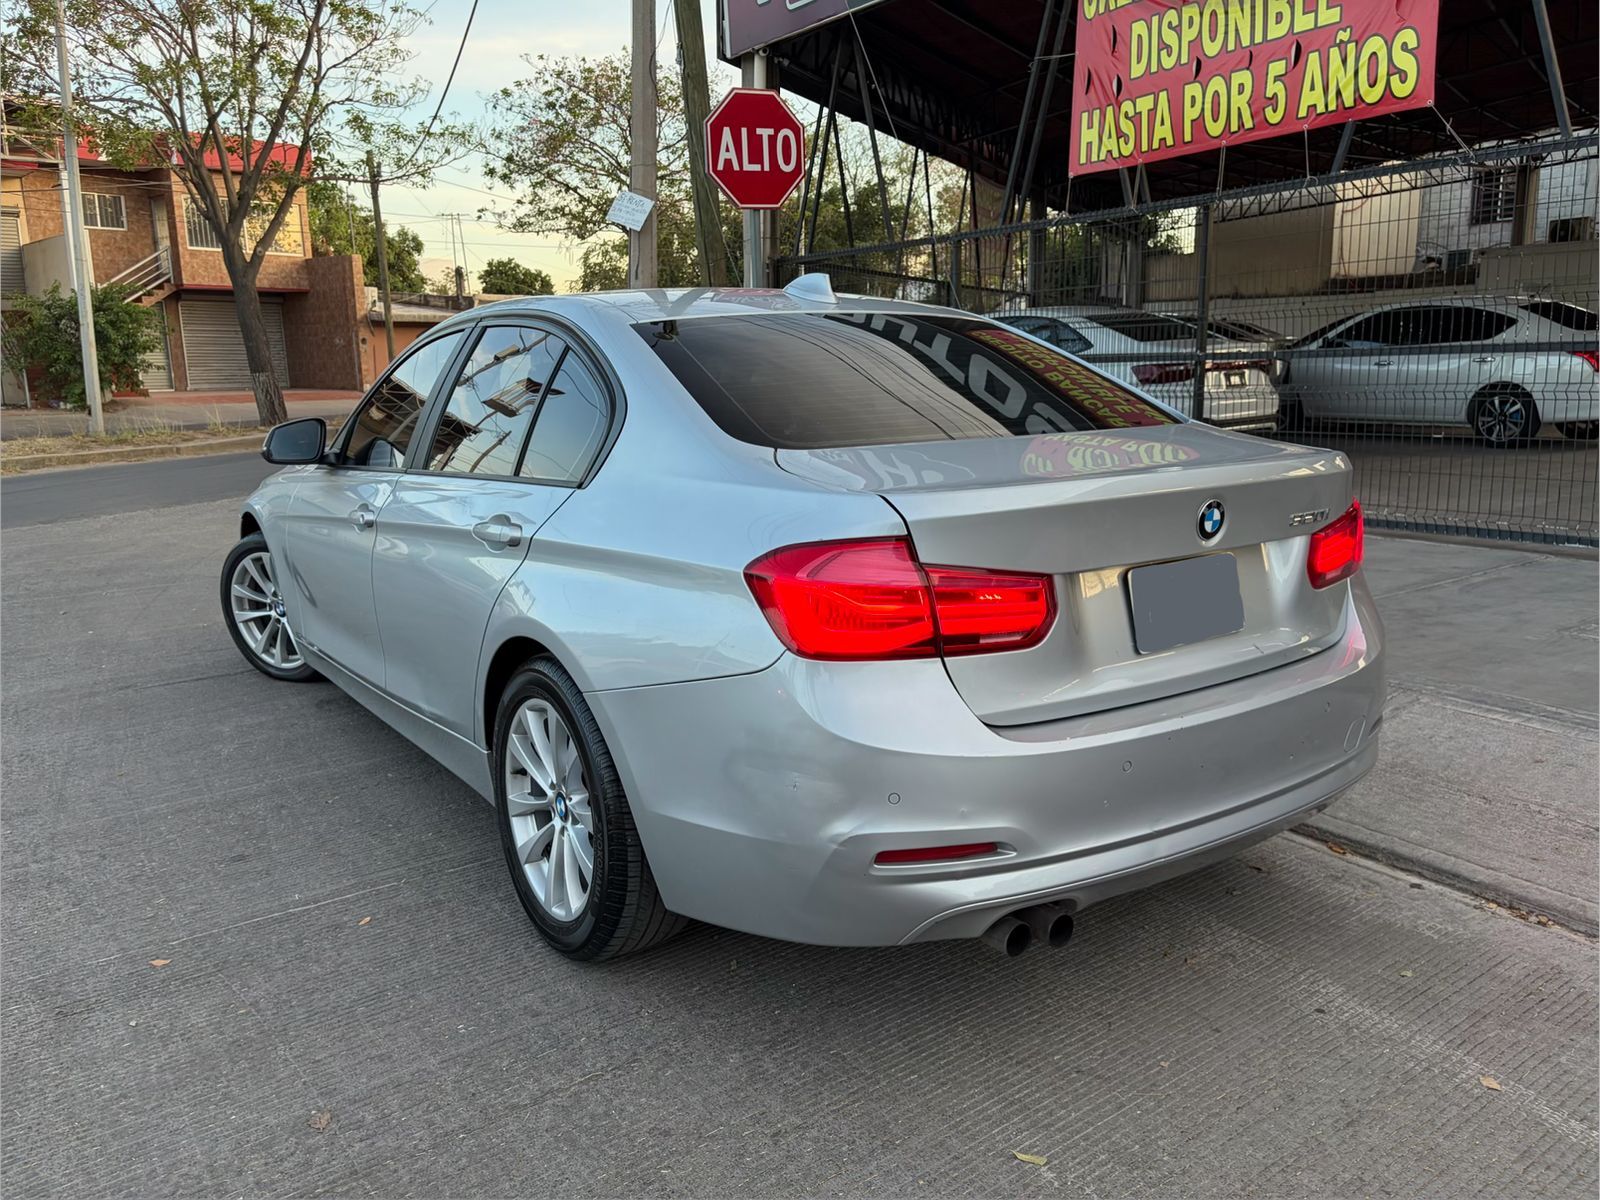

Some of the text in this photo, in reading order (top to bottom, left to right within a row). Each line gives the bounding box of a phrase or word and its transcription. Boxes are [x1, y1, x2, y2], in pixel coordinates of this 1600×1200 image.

[1080, 26, 1419, 165] HASTA POR 5 AÑOS
[717, 126, 797, 173] ALTO
[592, 832, 604, 903] YOKOHAMA
